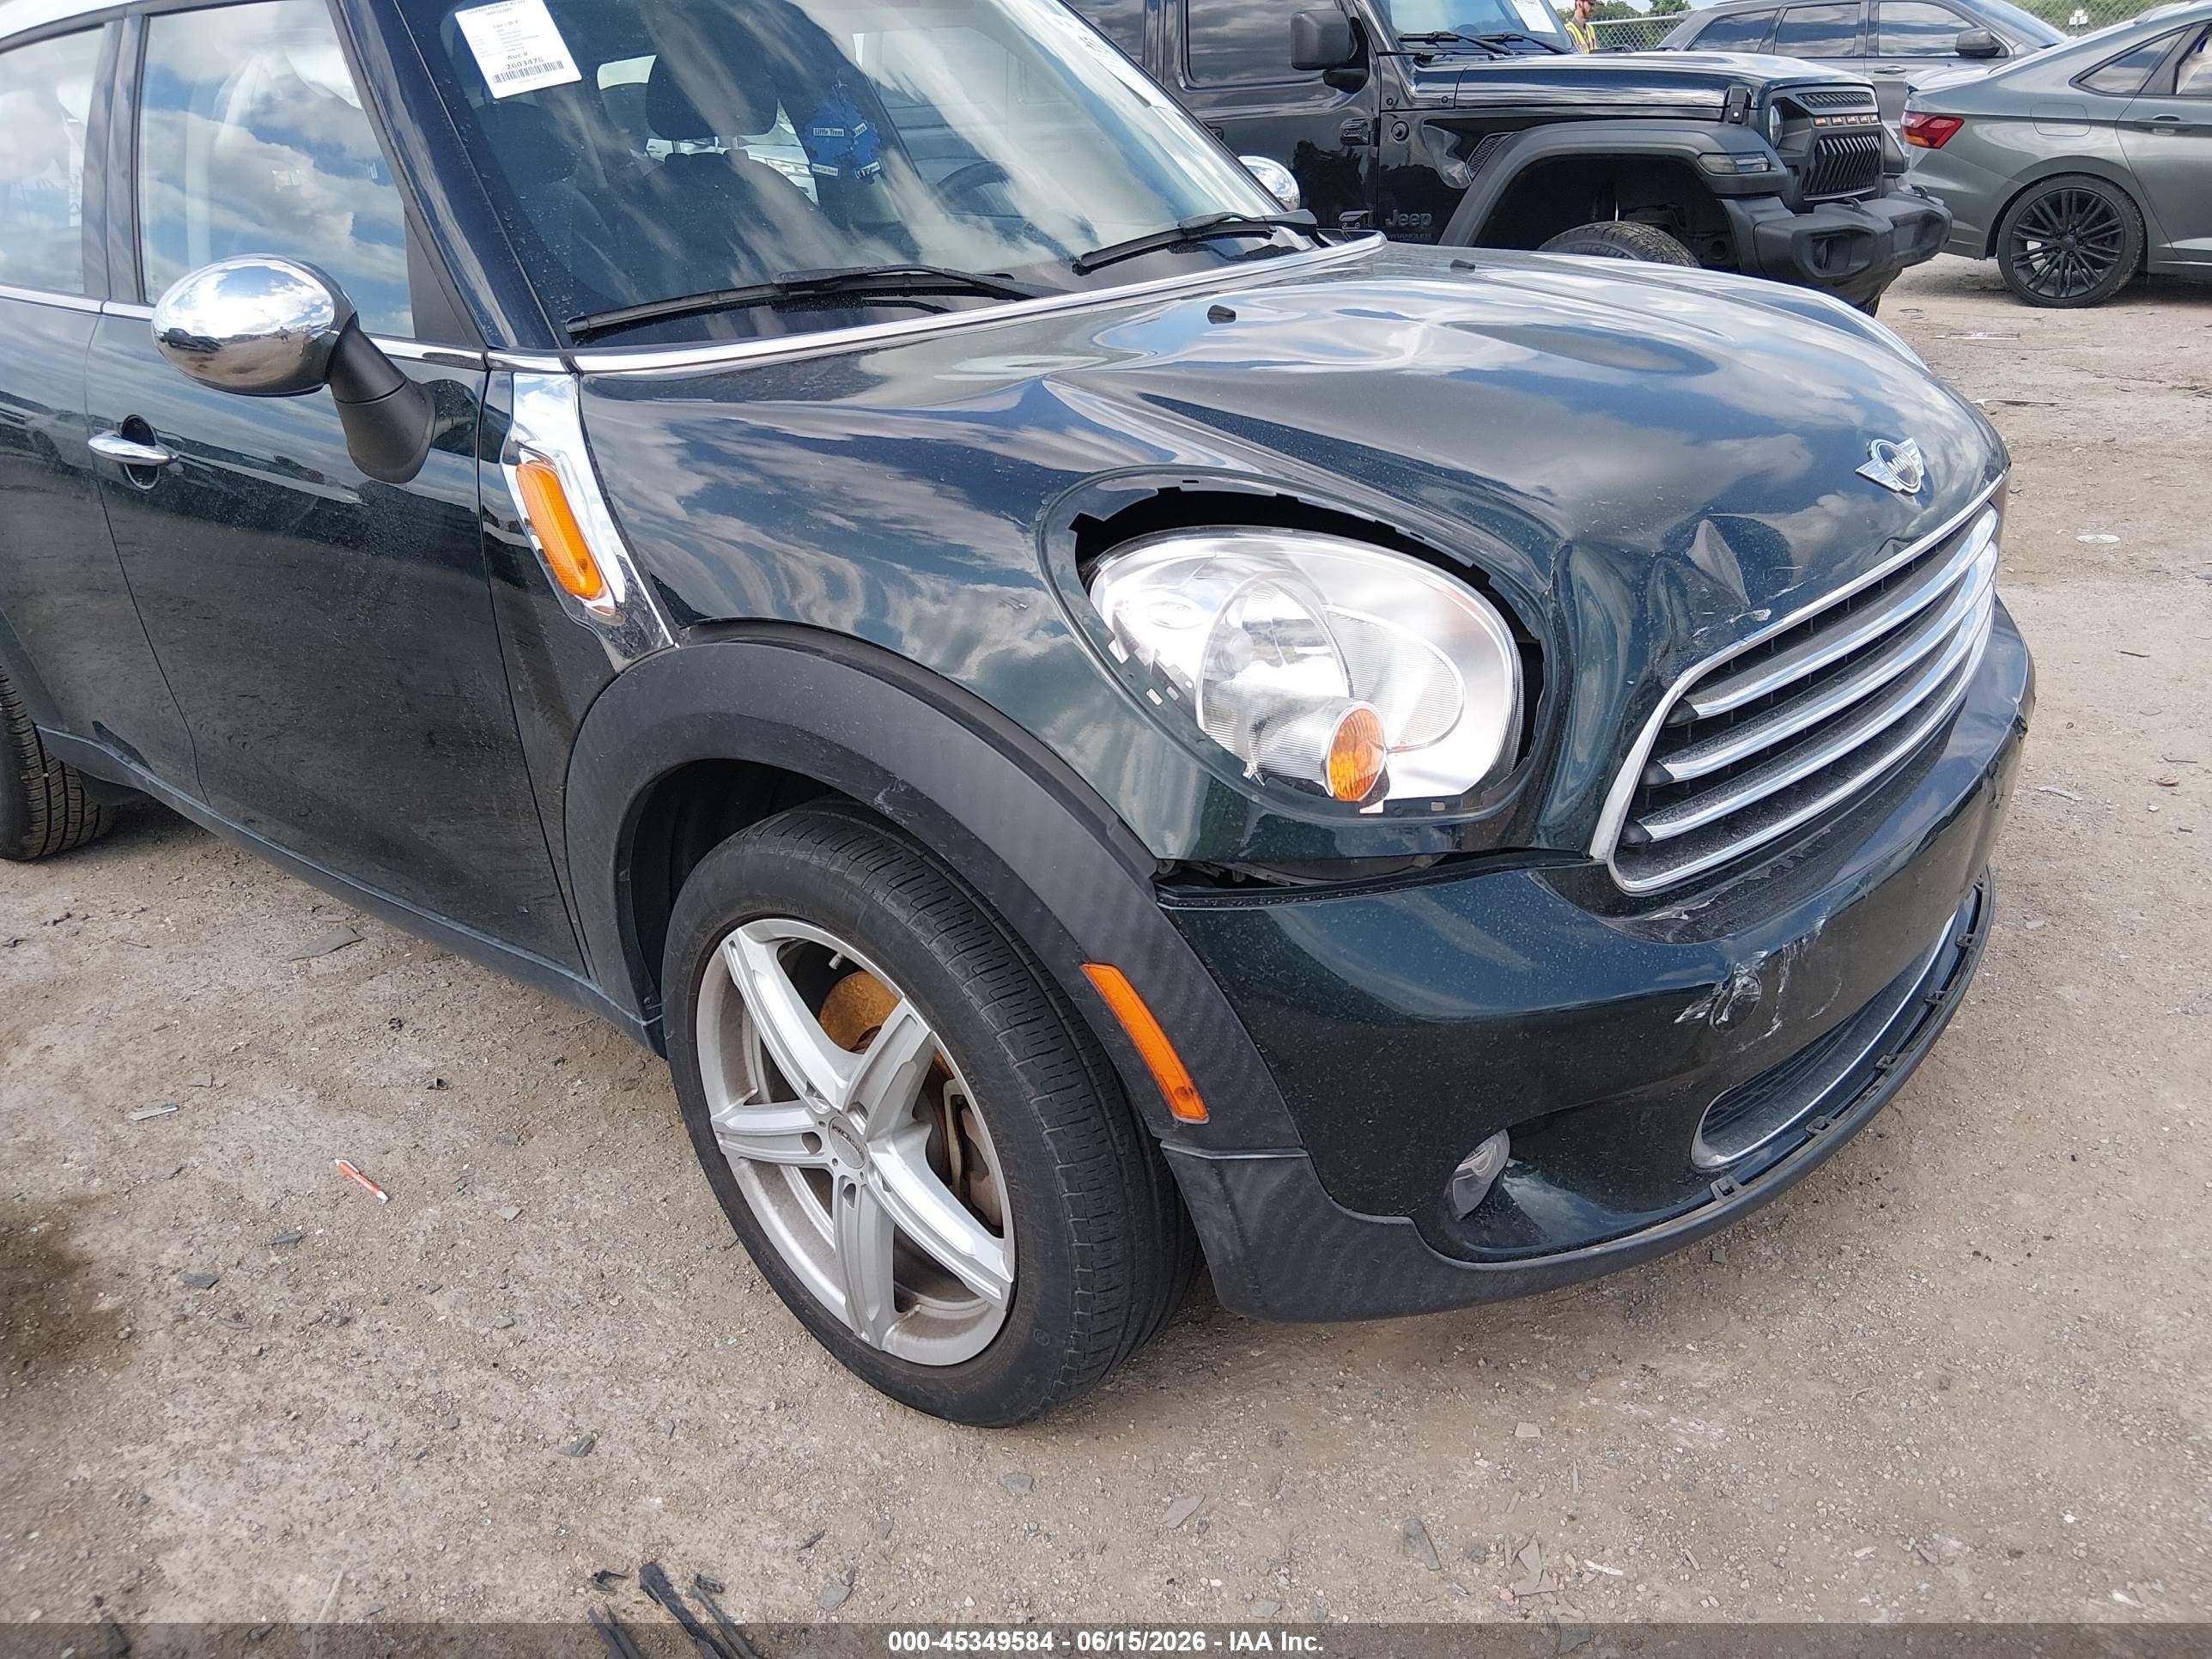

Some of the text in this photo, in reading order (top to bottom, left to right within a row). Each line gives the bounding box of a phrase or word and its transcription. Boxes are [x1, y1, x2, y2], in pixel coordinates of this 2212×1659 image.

[505, 57, 544, 70] 2603476
[1385, 209, 1432, 228] Jeep
[1886, 453, 1911, 475] MINI
